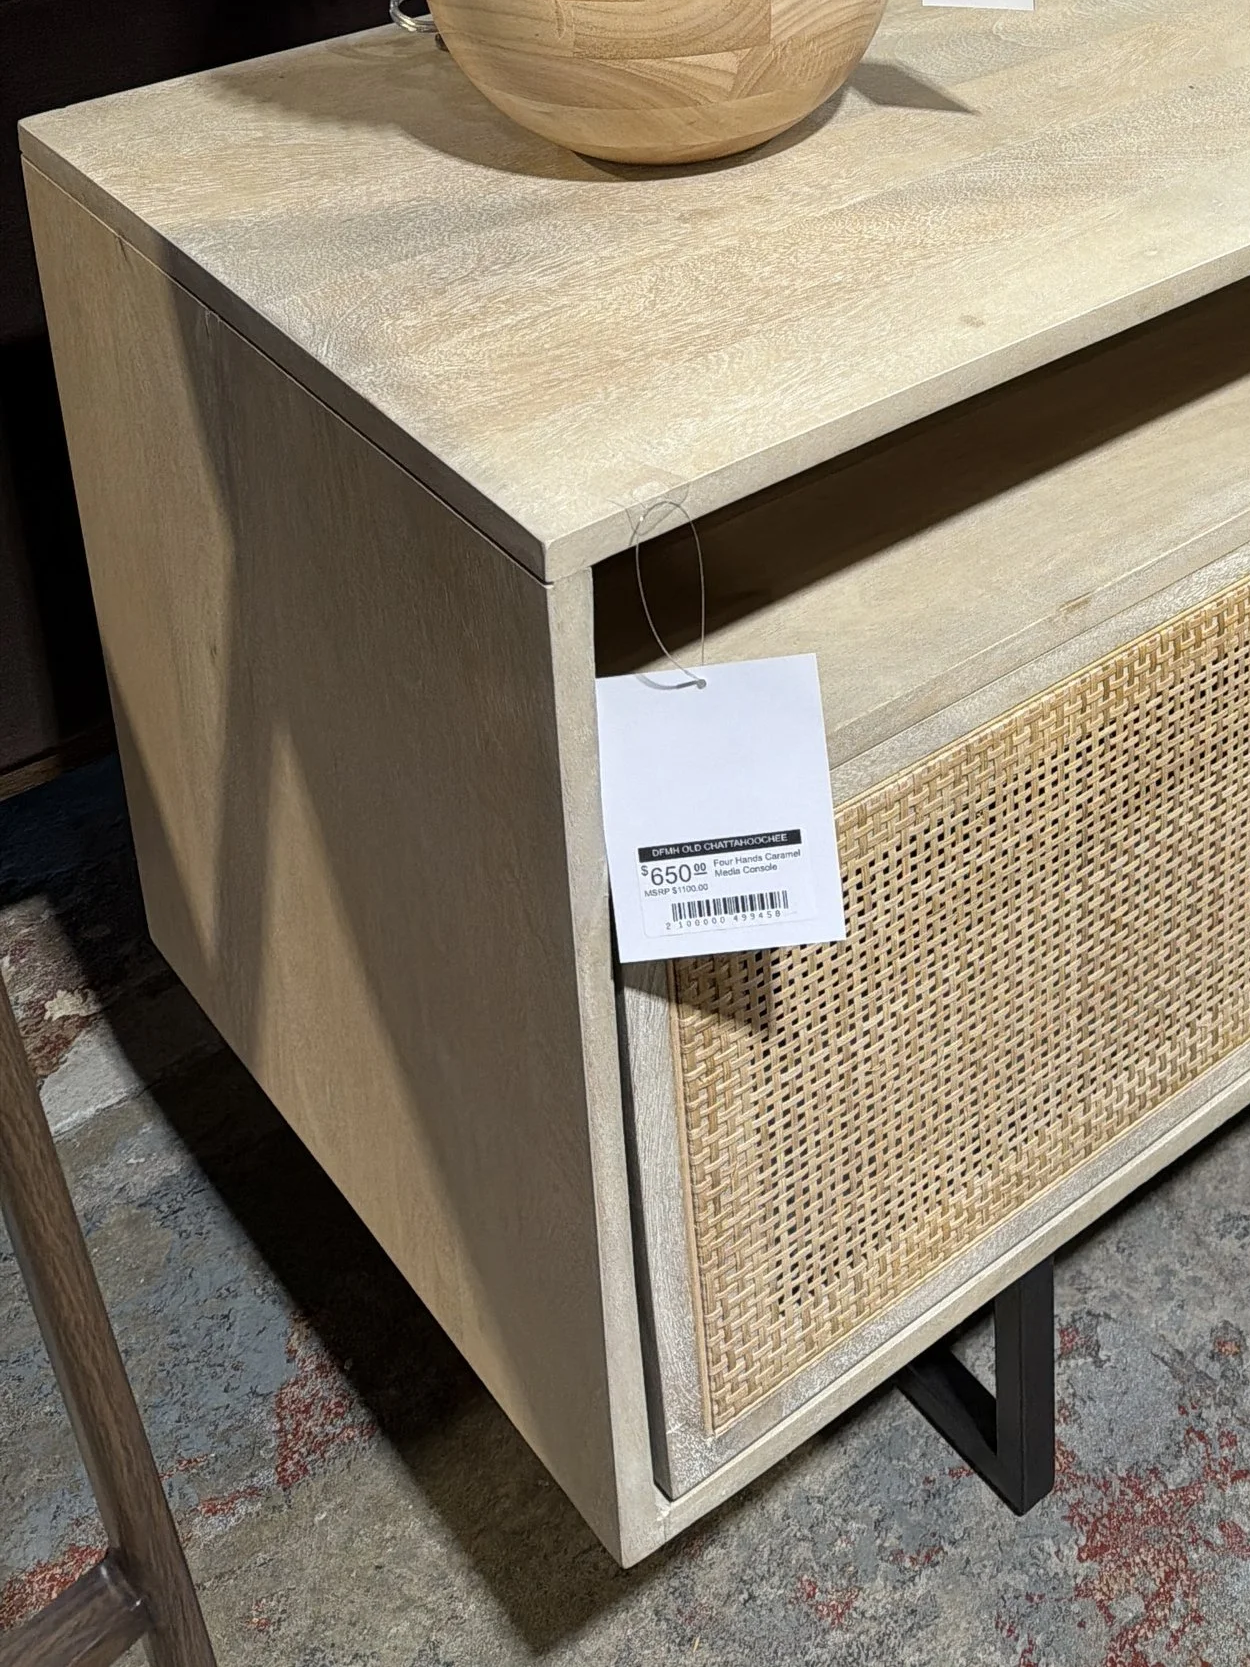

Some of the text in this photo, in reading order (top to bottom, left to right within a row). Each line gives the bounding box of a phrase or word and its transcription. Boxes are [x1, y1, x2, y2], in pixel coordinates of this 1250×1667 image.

[652, 833, 788, 857] DFMH OLD CHATTAHOOCHEE
[713, 848, 801, 868] Four Hands Caramel
[714, 863, 778, 877] Media Console
[644, 883, 709, 897] MSRP $1100.00
